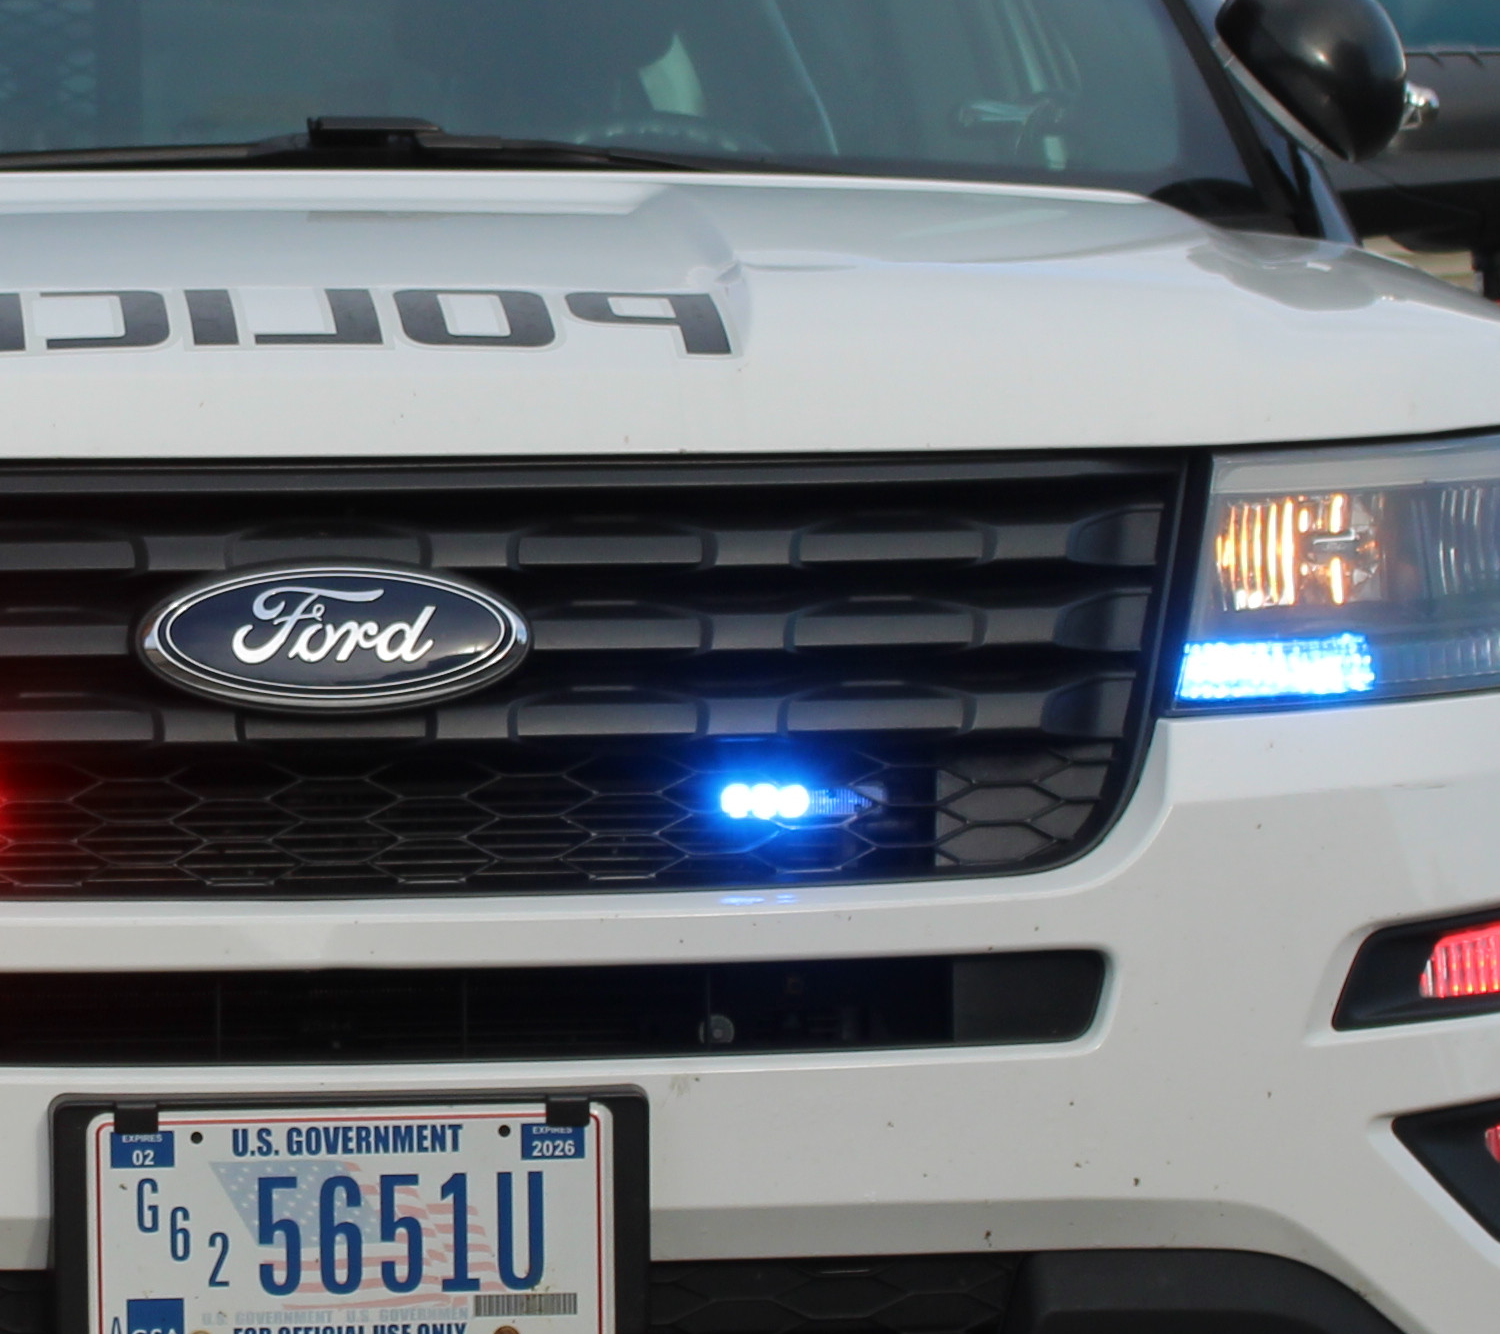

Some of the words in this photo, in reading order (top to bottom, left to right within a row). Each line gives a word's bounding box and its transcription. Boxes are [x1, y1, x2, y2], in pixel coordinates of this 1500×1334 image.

[231, 585, 437, 664] Ford
[121, 1133, 163, 1144] EXPIRES
[531, 1126, 574, 1135] EXPIRES
[232, 1127, 280, 1157] U.S.
[286, 1123, 464, 1156] GOVERNMENT
[531, 1140, 576, 1157] 2026
[131, 1150, 156, 1166] 02
[257, 1170, 545, 1296] 5651U
